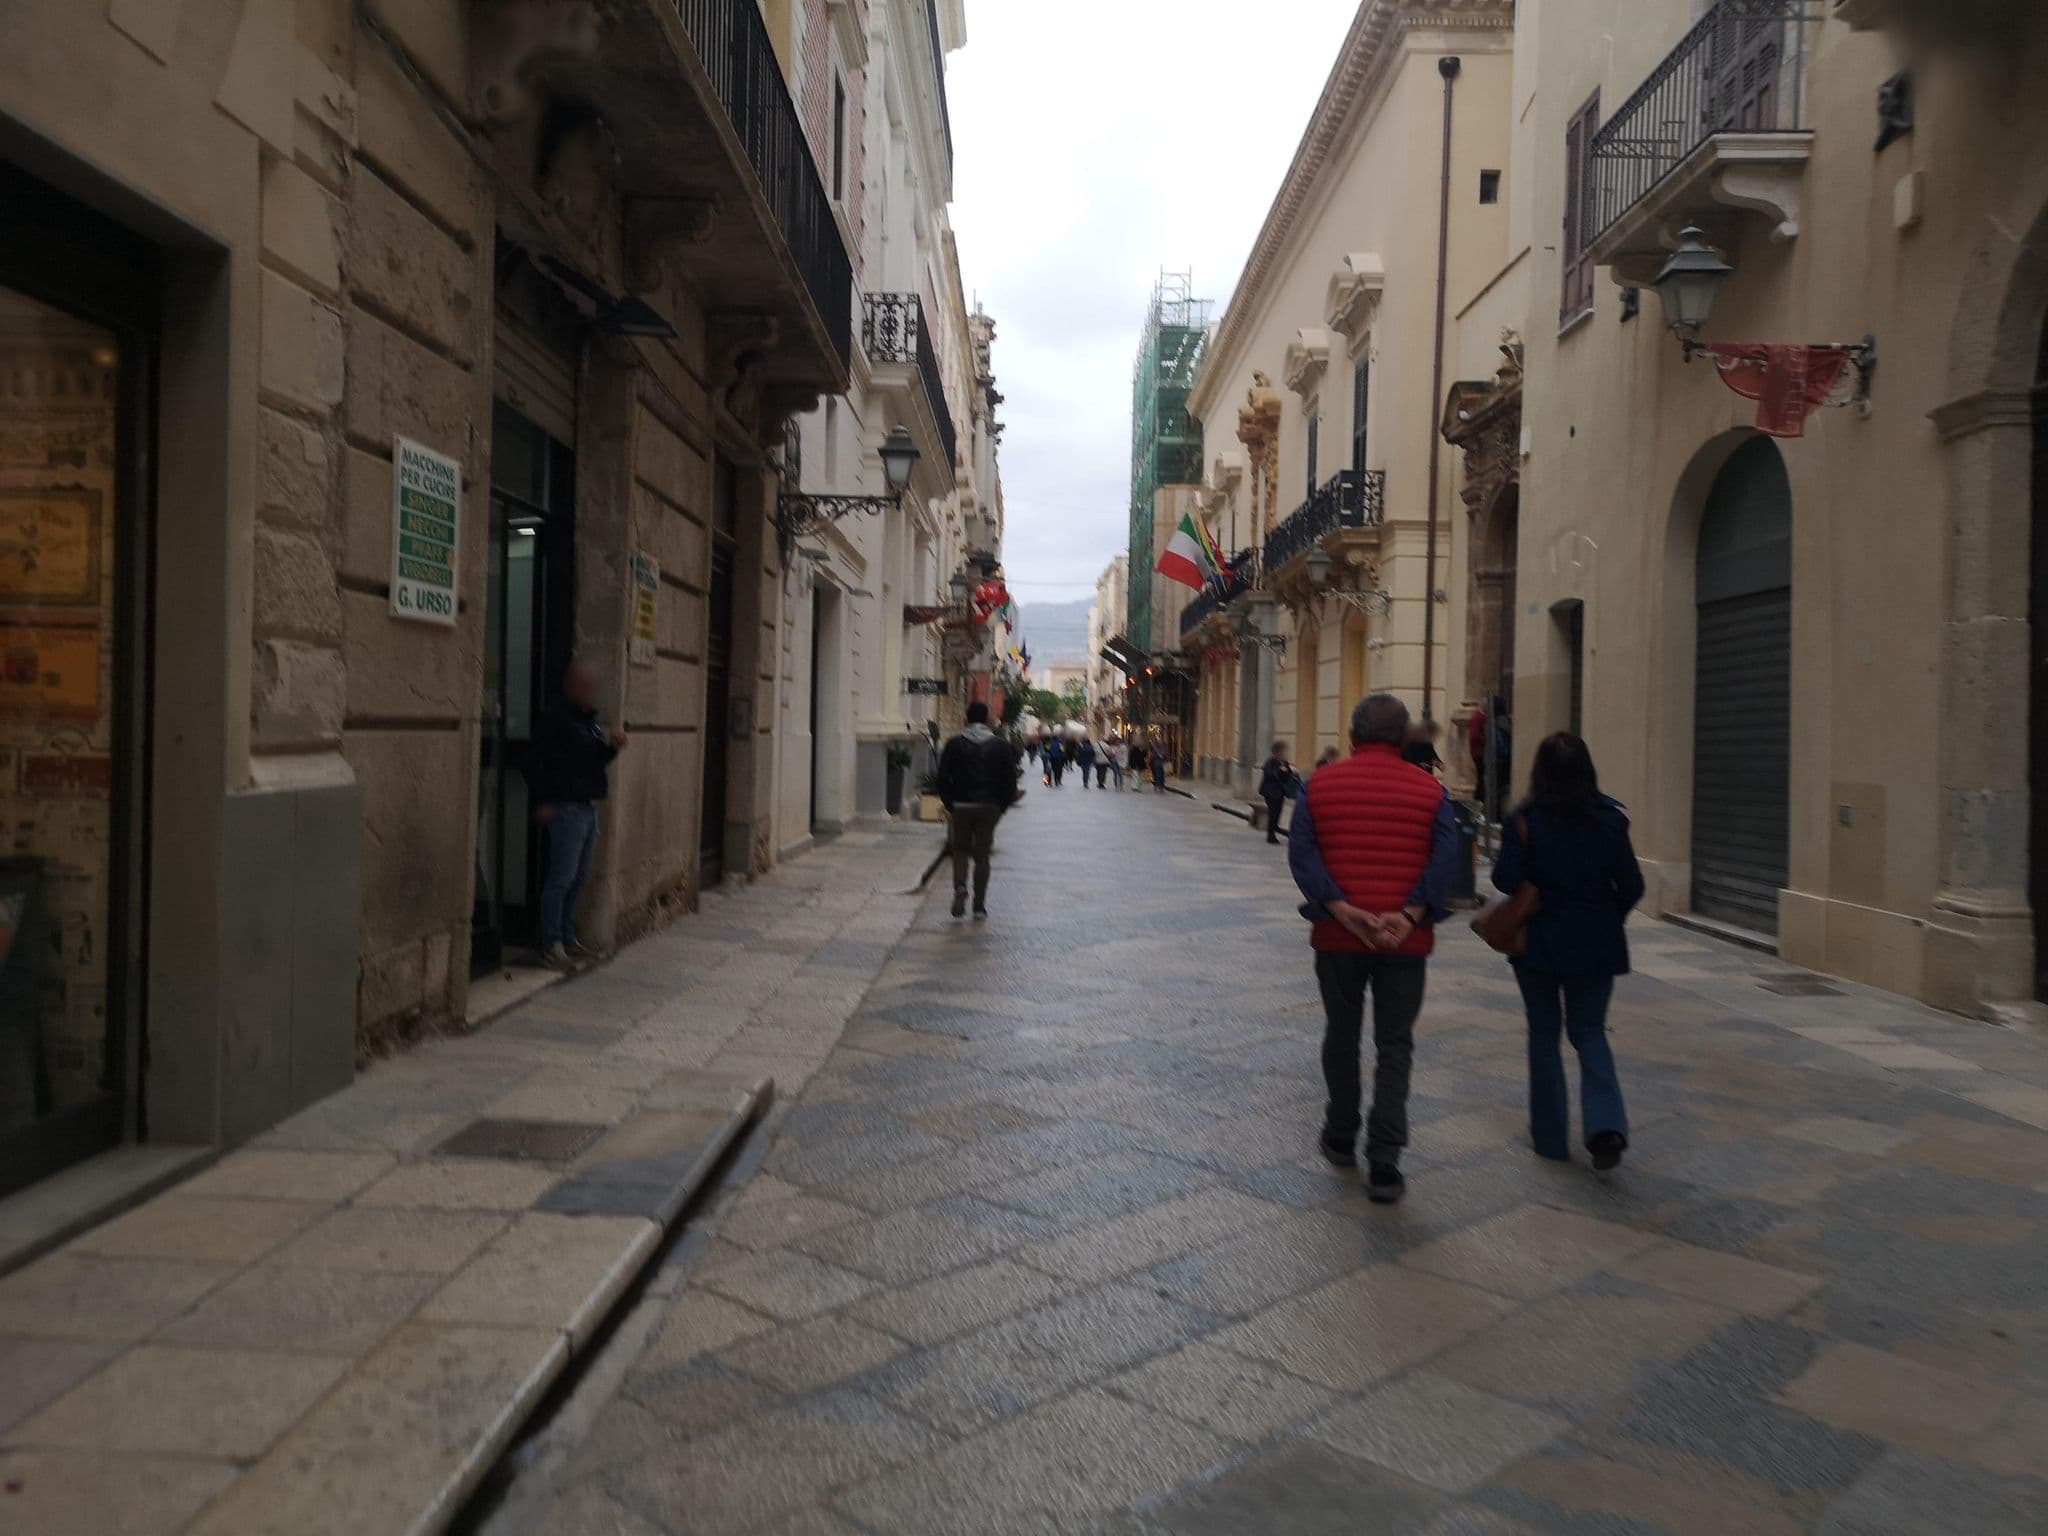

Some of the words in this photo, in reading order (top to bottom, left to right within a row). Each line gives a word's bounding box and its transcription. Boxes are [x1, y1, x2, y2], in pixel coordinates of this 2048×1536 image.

[402, 446, 455, 482] MACCHINE
[401, 465, 420, 487] PER
[422, 474, 456, 502] CUCIRE
[408, 493, 448, 519] SINGER
[408, 515, 449, 540] NECCHI
[399, 585, 412, 610] G.
[416, 587, 452, 616] URSO
